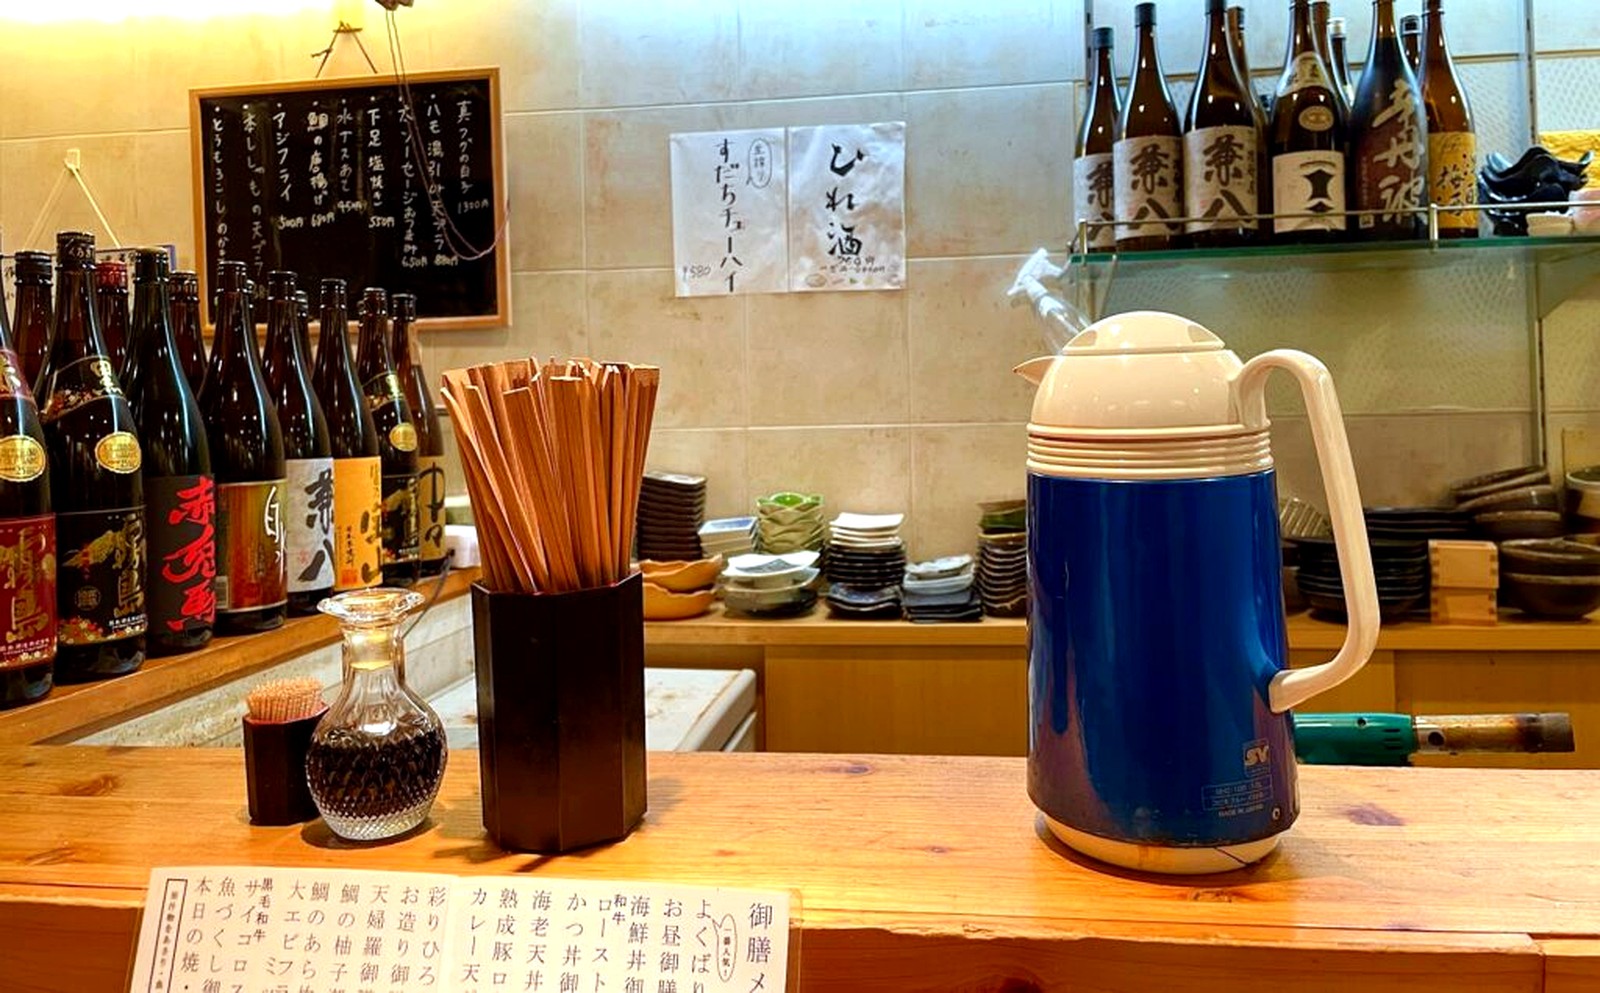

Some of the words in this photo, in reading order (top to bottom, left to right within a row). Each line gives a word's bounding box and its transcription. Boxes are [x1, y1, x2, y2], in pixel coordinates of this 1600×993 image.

[272, 111, 290, 202] アジフライ
[824, 141, 867, 257] ひれ酒
[1130, 143, 1179, 231] 兼八
[1202, 133, 1252, 223] 兼八
[713, 138, 744, 293] すだちチューハイ
[253, 877, 273, 943] 黒毛和牛
[328, 883, 360, 993] 鯛の柚子
[358, 884, 391, 993] 天婦羅御
[390, 886, 419, 993] お造り御
[417, 886, 447, 986] 彩りひろ
[461, 888, 488, 993] カレー天
[492, 888, 519, 985] 熟成豚ロ
[592, 898, 613, 993] ロースト
[613, 894, 628, 925] 和牛
